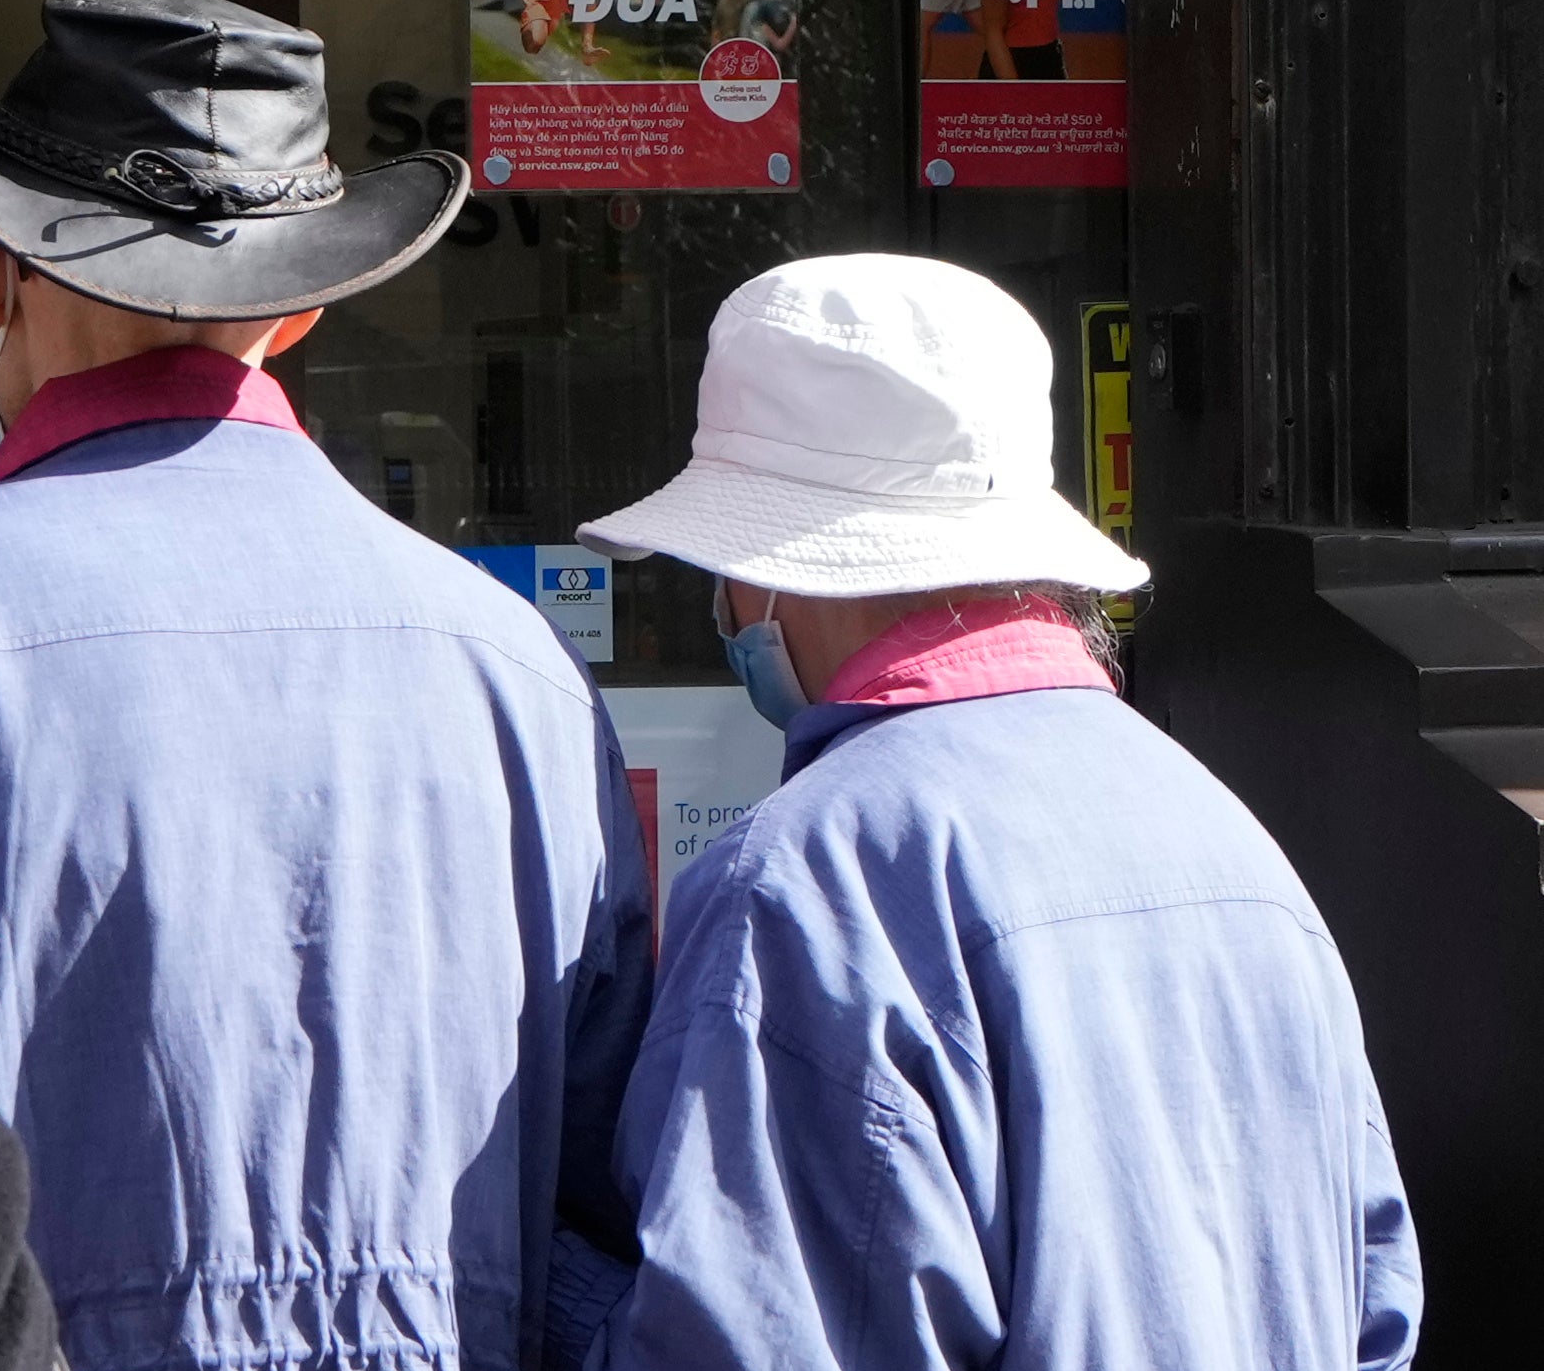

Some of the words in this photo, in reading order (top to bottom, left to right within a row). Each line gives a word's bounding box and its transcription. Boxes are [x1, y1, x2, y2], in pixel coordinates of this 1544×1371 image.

[719, 85, 745, 93] Active
[746, 85, 762, 93] and
[714, 94, 747, 102] Creative
[749, 94, 767, 102] Kids
[541, 105, 555, 114] tra
[1071, 115, 1093, 125] $50
[552, 133, 568, 142] xin
[653, 145, 667, 154] 50
[950, 144, 1050, 155] service.nsw.gov.au
[519, 161, 619, 172] service.nsw.gov.au
[556, 591, 591, 601] record
[569, 630, 584, 638] 674
[674, 803, 700, 824] To
[675, 834, 698, 855] of
